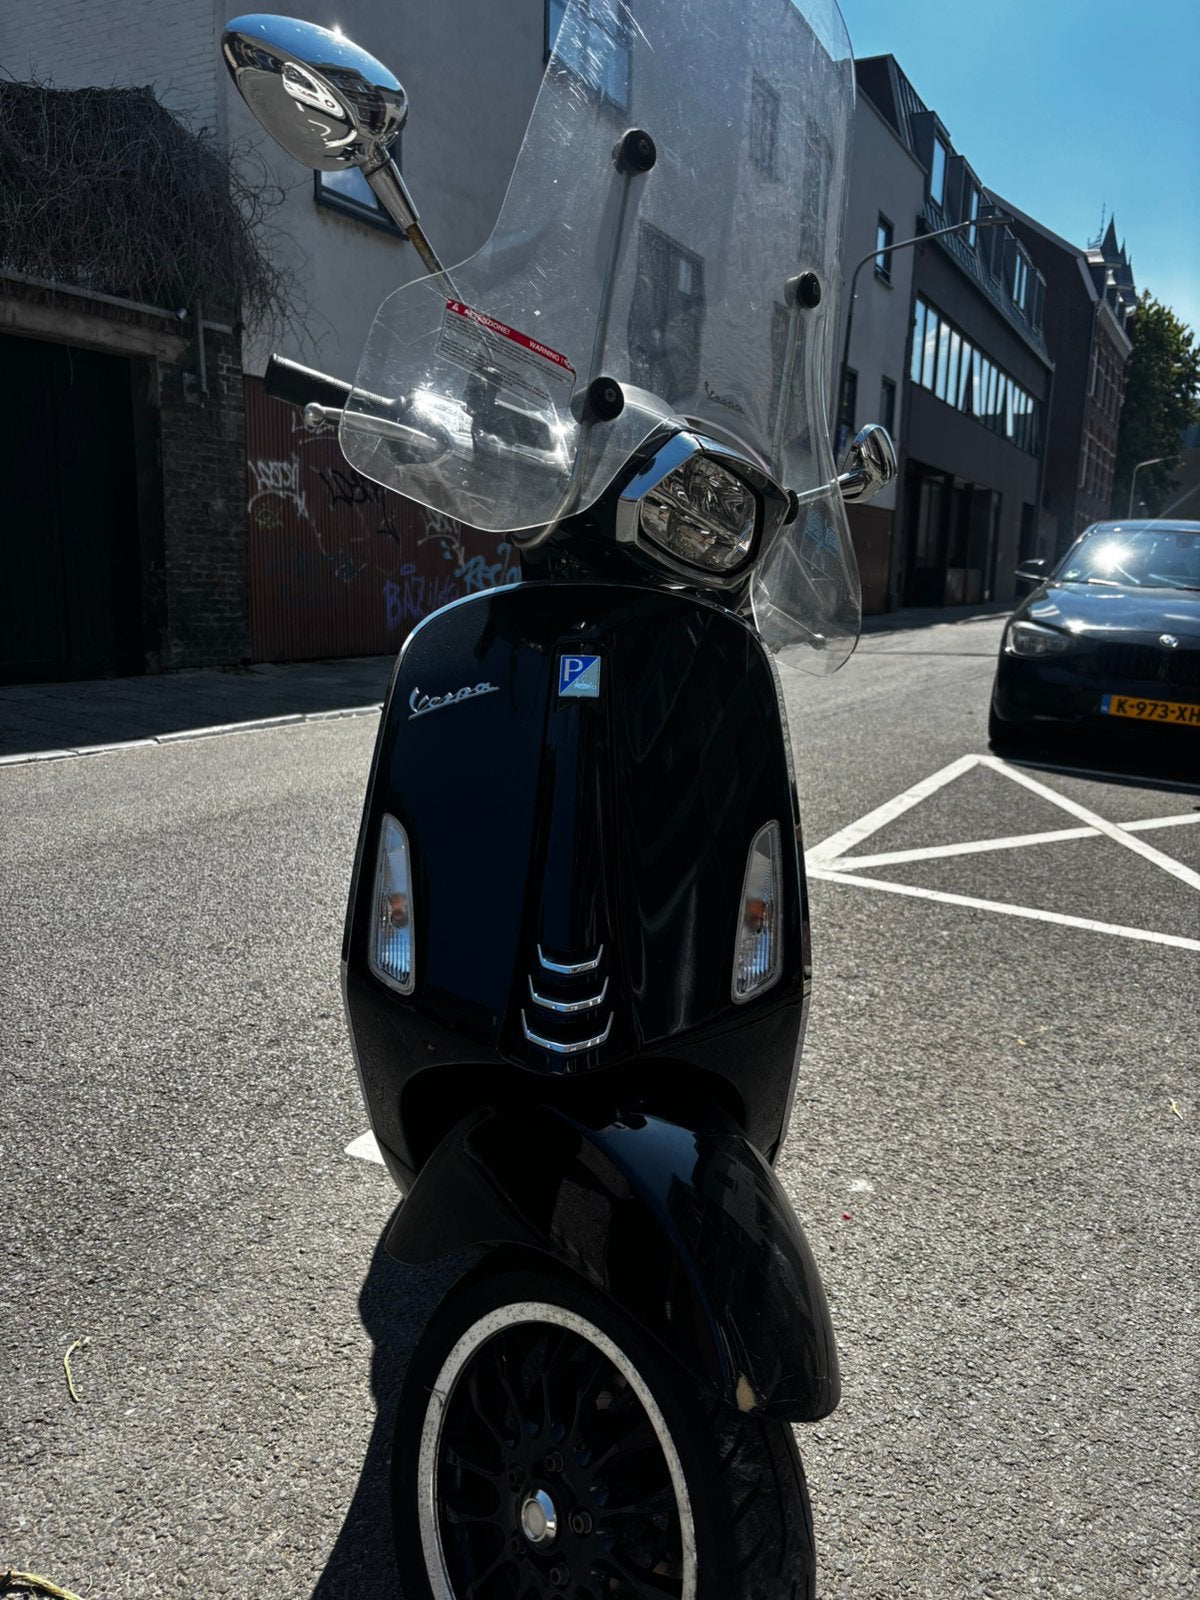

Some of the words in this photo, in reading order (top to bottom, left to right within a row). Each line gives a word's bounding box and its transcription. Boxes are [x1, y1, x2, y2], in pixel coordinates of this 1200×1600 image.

[563, 657, 584, 682] P
[408, 682, 499, 721] Vespa
[1116, 698, 1200, 724] K-973-XH
